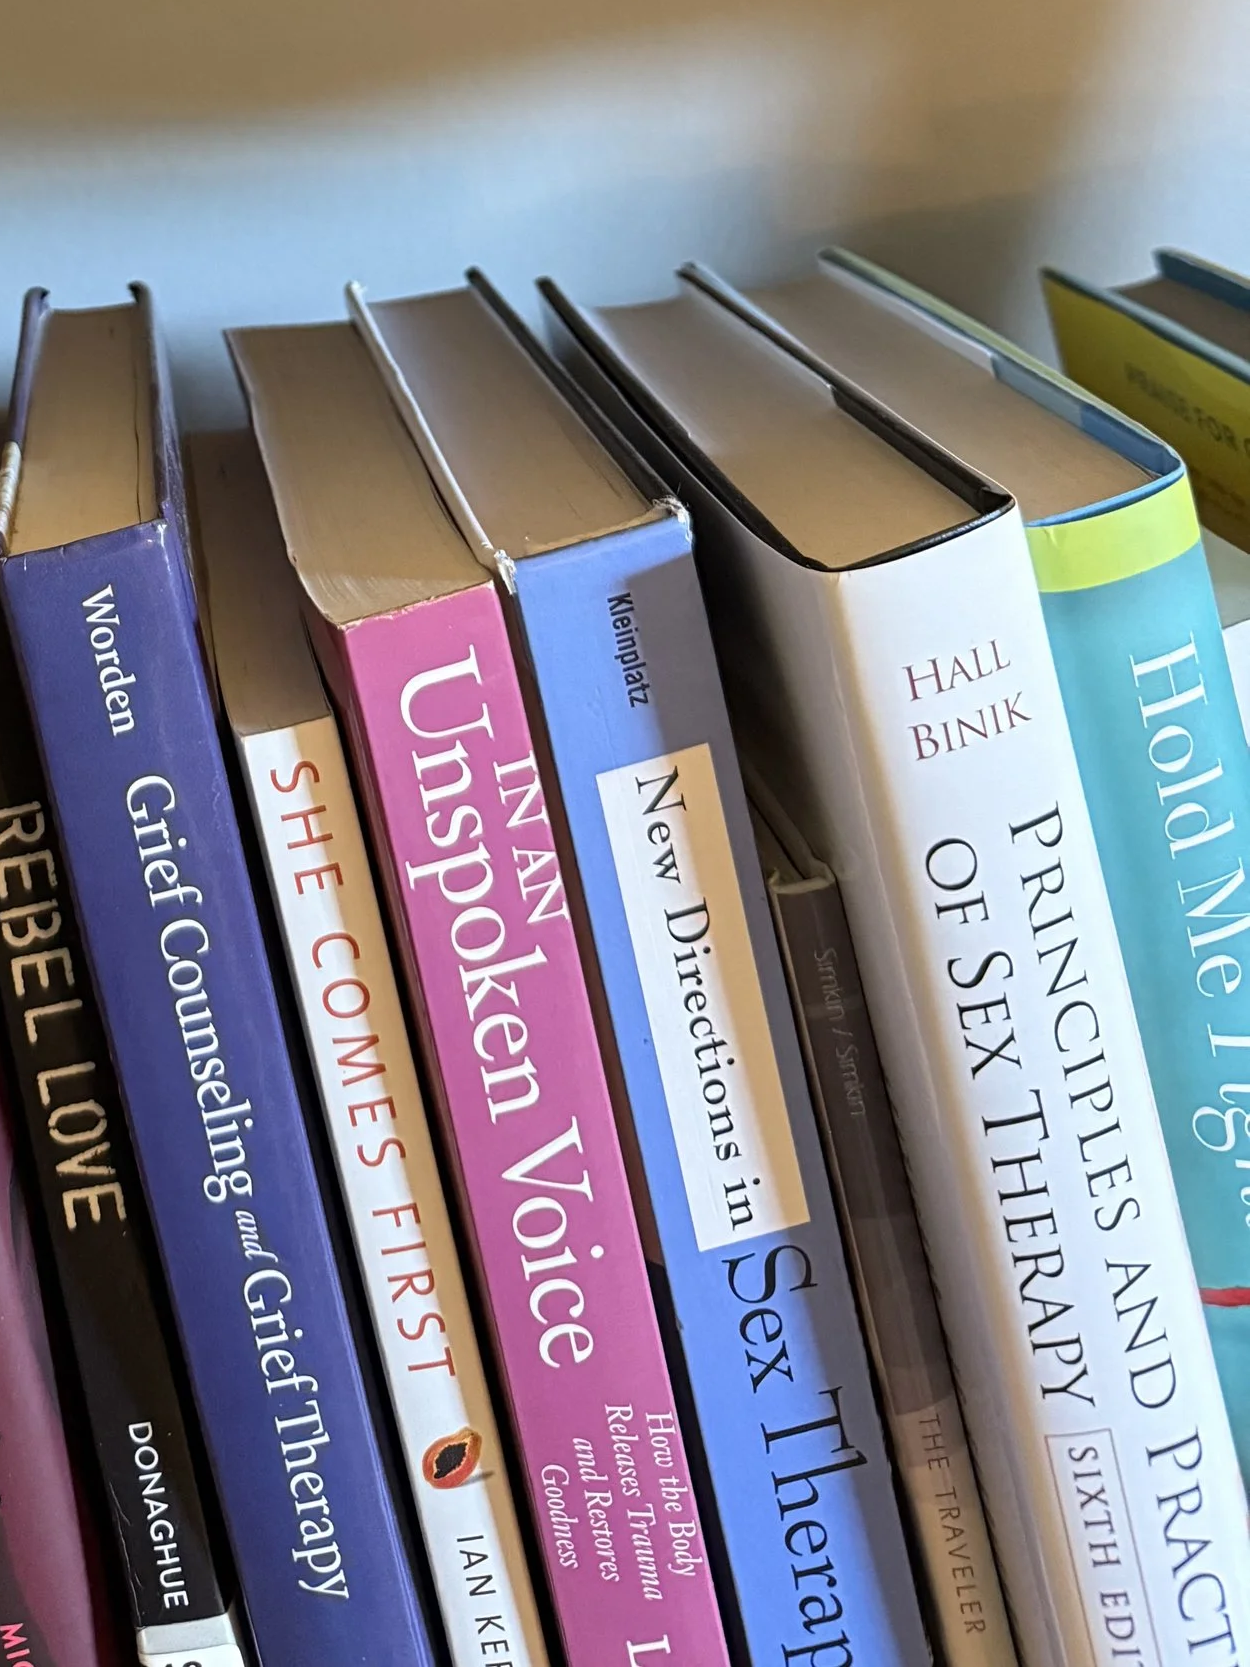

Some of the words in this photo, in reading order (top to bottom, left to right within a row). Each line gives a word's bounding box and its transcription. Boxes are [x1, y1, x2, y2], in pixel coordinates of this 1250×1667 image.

[81, 584, 137, 737] Worden
[607, 592, 651, 708] Kleinplatz
[901, 639, 1011, 703] HALL
[907, 691, 1033, 761] BINIK
[1129, 631, 1235, 859] Hold
[125, 774, 202, 907] Grief
[493, 750, 553, 829] IN
[513, 845, 570, 924] AN
[924, 836, 990, 924] OF
[399, 644, 547, 1123] Unspoken
[502, 1115, 604, 1368] Voice
[635, 766, 684, 885] New
[663, 898, 741, 1161] Directions
[723, 1177, 762, 1232] in
[814, 947, 845, 1021] Simkin
[947, 949, 1022, 1081] SEX
[159, 918, 253, 1205] Counseling
[270, 760, 344, 896] SHE
[311, 933, 406, 1168] COMES
[372, 1202, 455, 1379] FIRST
[1008, 800, 1141, 1234] PRINCIPLES
[1105, 1258, 1177, 1409] AND
[36, 1061, 127, 1232] LOVE
[235, 1210, 277, 1263] and
[981, 1089, 1095, 1408] THERAPY
[243, 1268, 317, 1394] Grief
[722, 1244, 818, 1394] Sex
[275, 1399, 350, 1601] Therapy
[573, 1438, 604, 1483] and
[646, 1411, 676, 1467] How
[658, 1477, 685, 1515] the
[919, 1413, 950, 1470] THE
[127, 1420, 188, 1610] DONAGHUE
[542, 1464, 578, 1570] Goodness
[585, 1488, 619, 1582] Restores
[605, 1403, 639, 1499] Releases
[626, 1503, 666, 1601] Trauma
[668, 1519, 704, 1576] Body
[932, 1486, 987, 1635] TRAVELER
[1067, 1446, 1121, 1569] SIXTH
[456, 1535, 496, 1597] IAN
